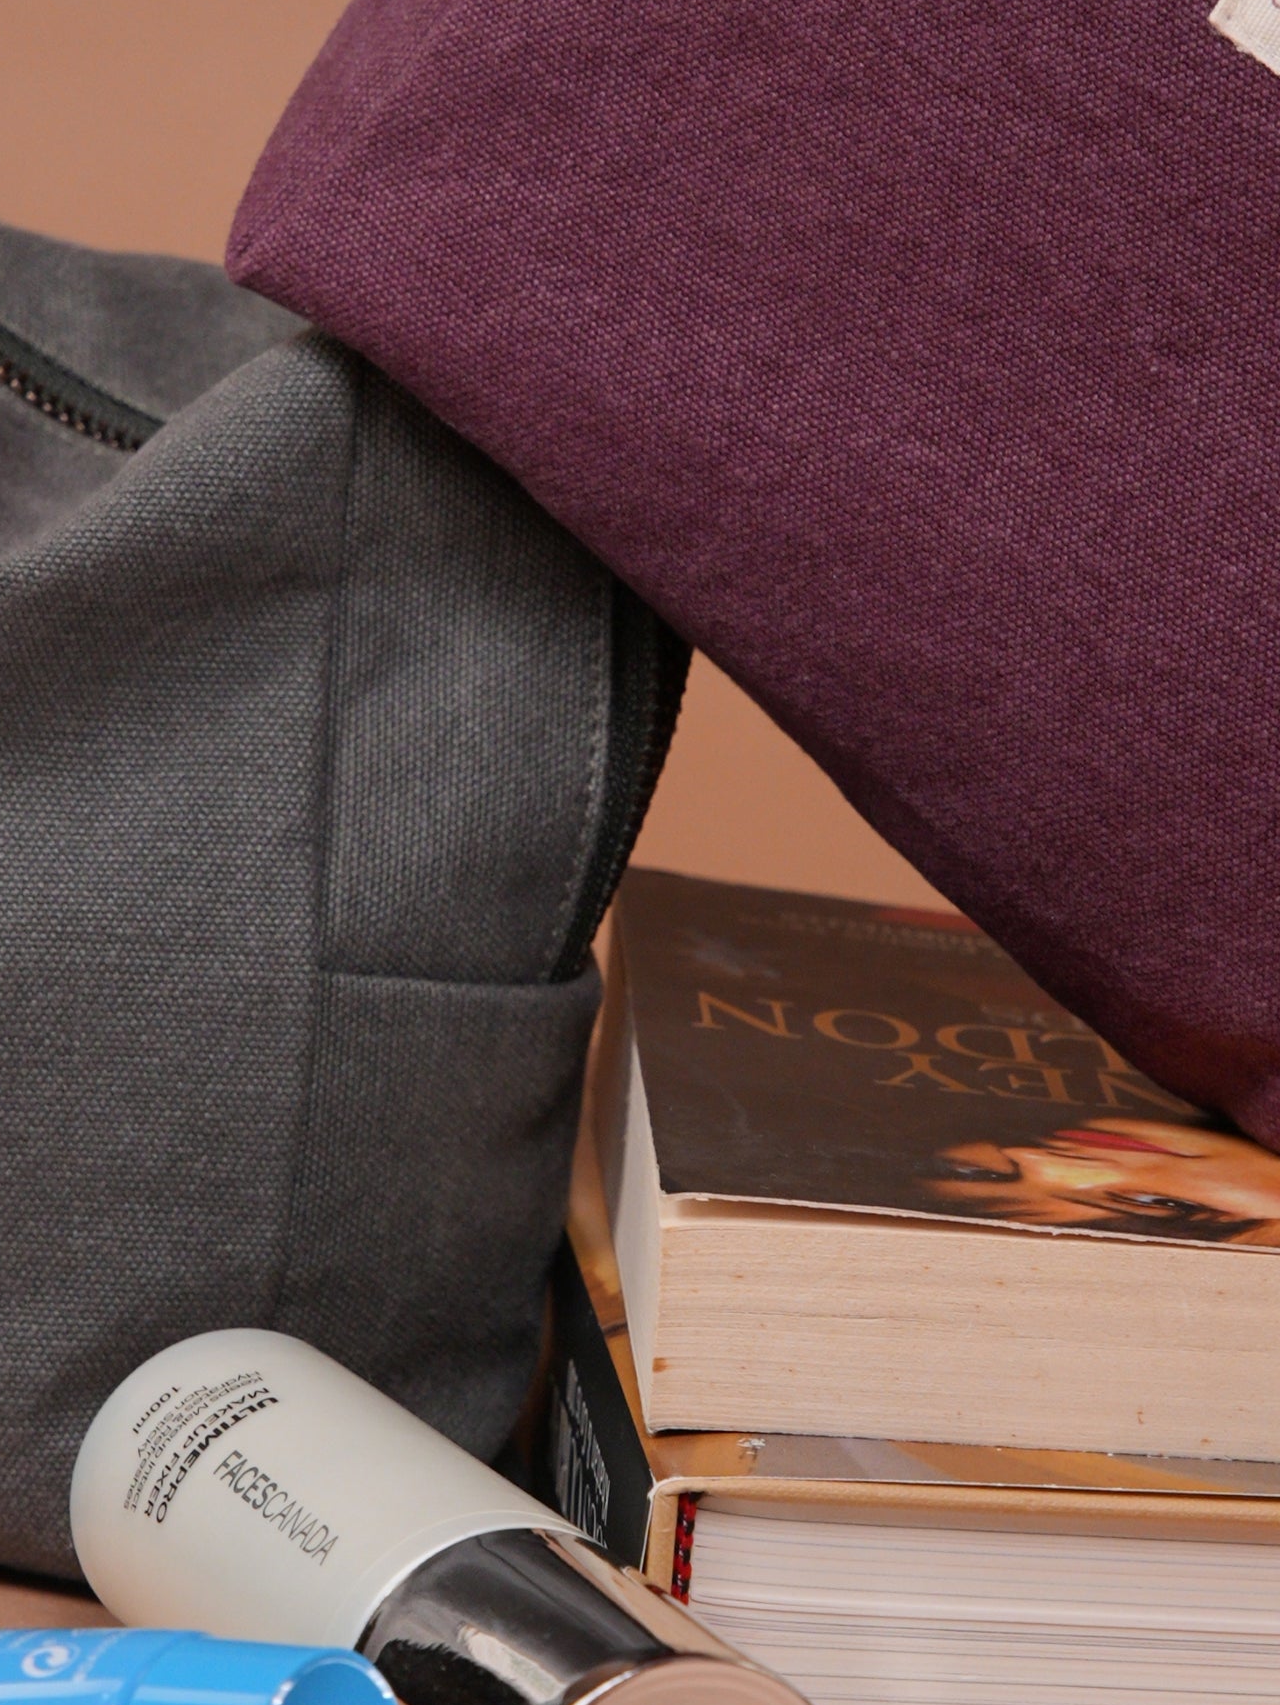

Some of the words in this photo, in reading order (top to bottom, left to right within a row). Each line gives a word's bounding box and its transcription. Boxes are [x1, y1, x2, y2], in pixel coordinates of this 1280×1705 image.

[132, 1386, 182, 1434] 100ml
[175, 1385, 208, 1409] Non
[184, 1371, 261, 1411] Hydrates
[210, 1376, 263, 1402] Keeps
[138, 1412, 174, 1457] Sticky
[155, 1402, 209, 1458] Makeup
[183, 1387, 270, 1449] MAKEUP
[144, 1452, 180, 1517] FIXER
[156, 1397, 279, 1523] ULTIMEPRO
[132, 1462, 156, 1513] Intact
[213, 1449, 339, 1566] FACESCANADA
